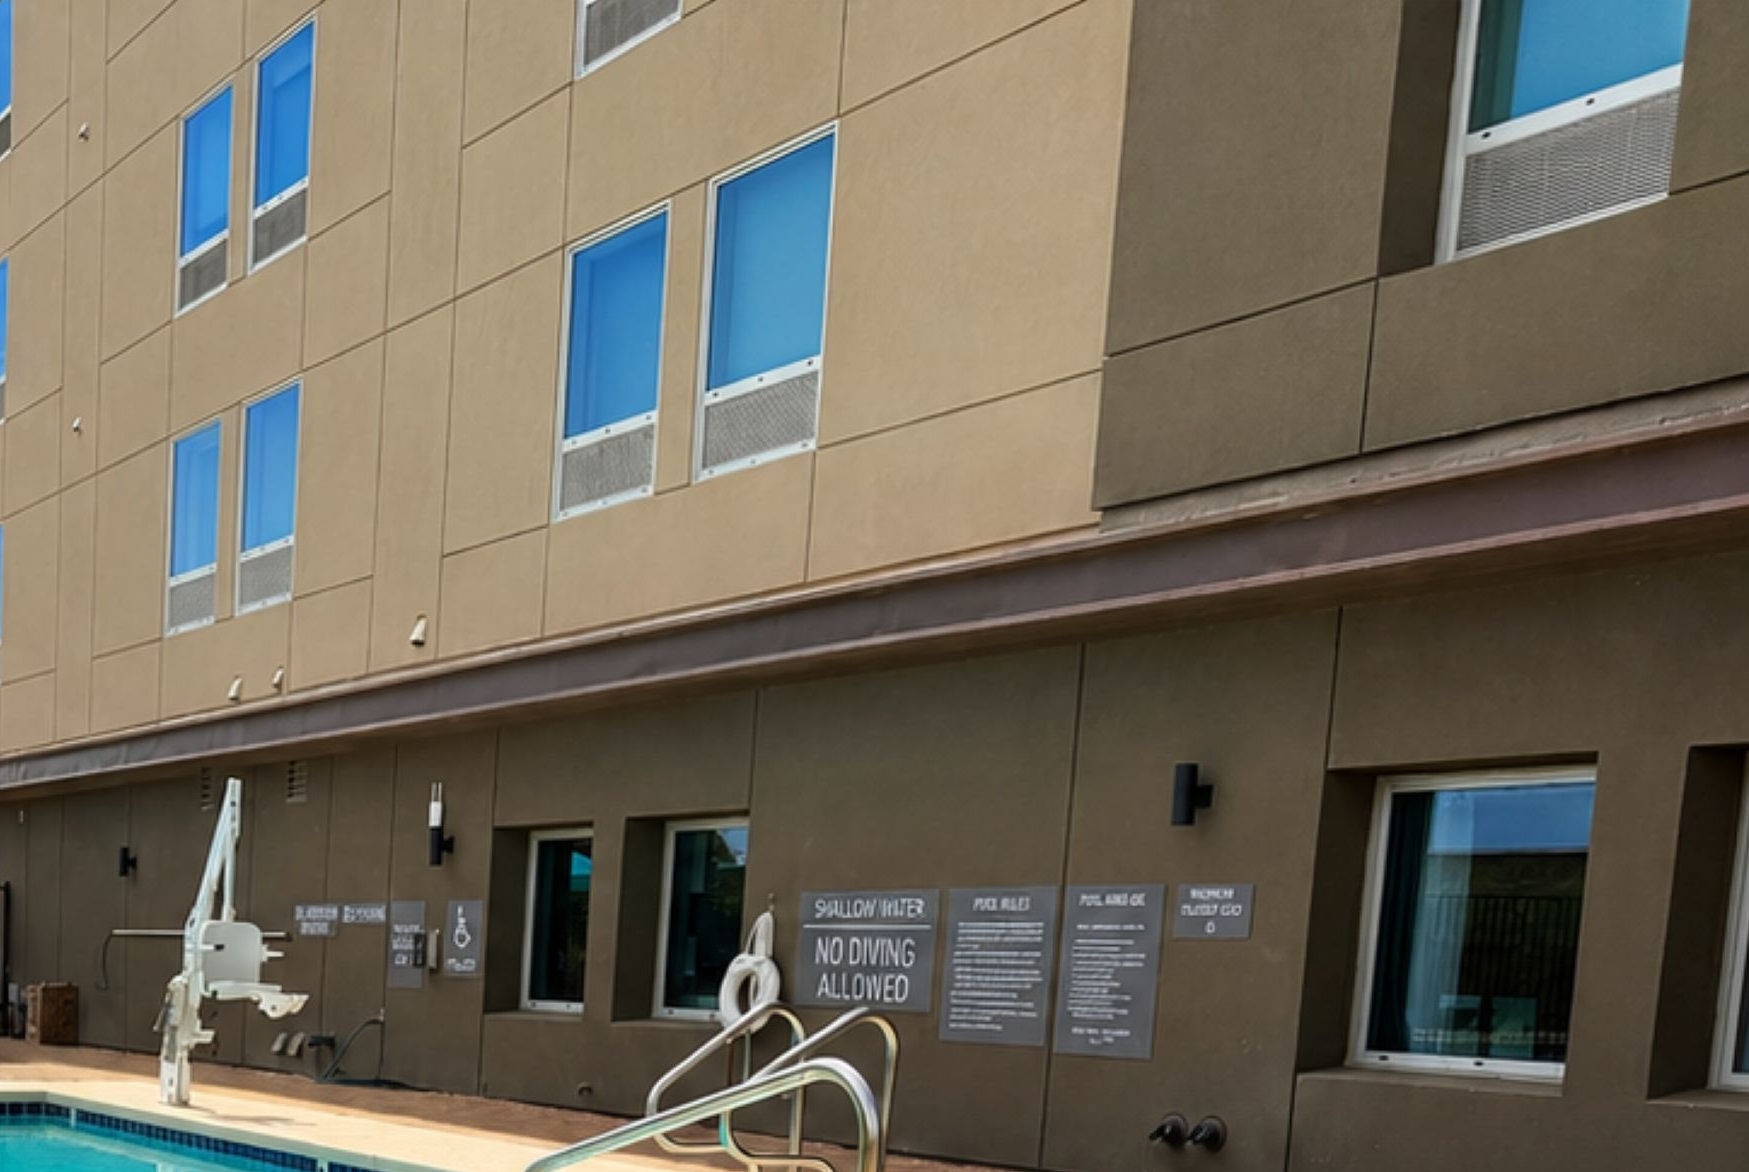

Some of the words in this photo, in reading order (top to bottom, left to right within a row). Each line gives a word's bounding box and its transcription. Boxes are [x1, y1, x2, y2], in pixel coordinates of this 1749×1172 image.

[814, 898, 877, 918] SHALLOW
[815, 936, 844, 965] NO
[849, 936, 915, 967] DIVING
[817, 972, 909, 1003] ALLOWED
